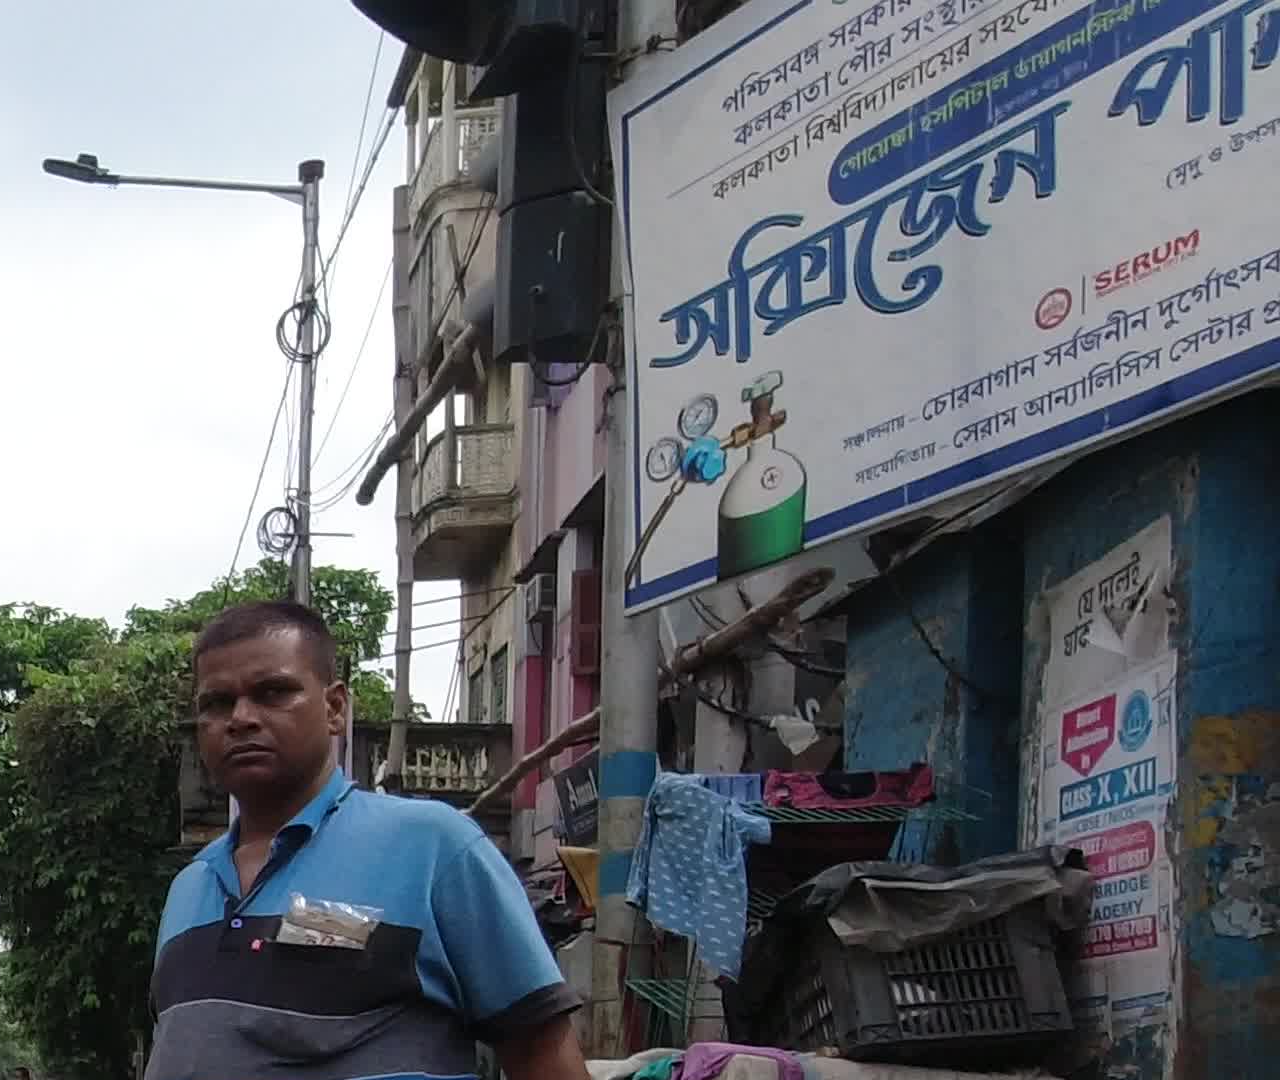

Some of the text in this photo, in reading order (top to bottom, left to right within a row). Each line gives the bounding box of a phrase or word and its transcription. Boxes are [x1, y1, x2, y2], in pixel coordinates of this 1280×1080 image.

[722, 40, 823, 113] পশ্চিমবঙ্গ
[733, 71, 832, 146] কলকাতা
[838, 33, 895, 86] পৌর
[712, 135, 801, 201] কলকাতা
[648, 99, 1072, 369] অক্সিজেন
[1094, 228, 1201, 291] SERUM
[921, 354, 1039, 422] চোরবাগান
[1042, 306, 1150, 369] সর্বজনীন
[952, 405, 1019, 450] সেরাম
[1169, 308, 1255, 363] সেন্টার
[1123, 759, 1154, 798] XII
